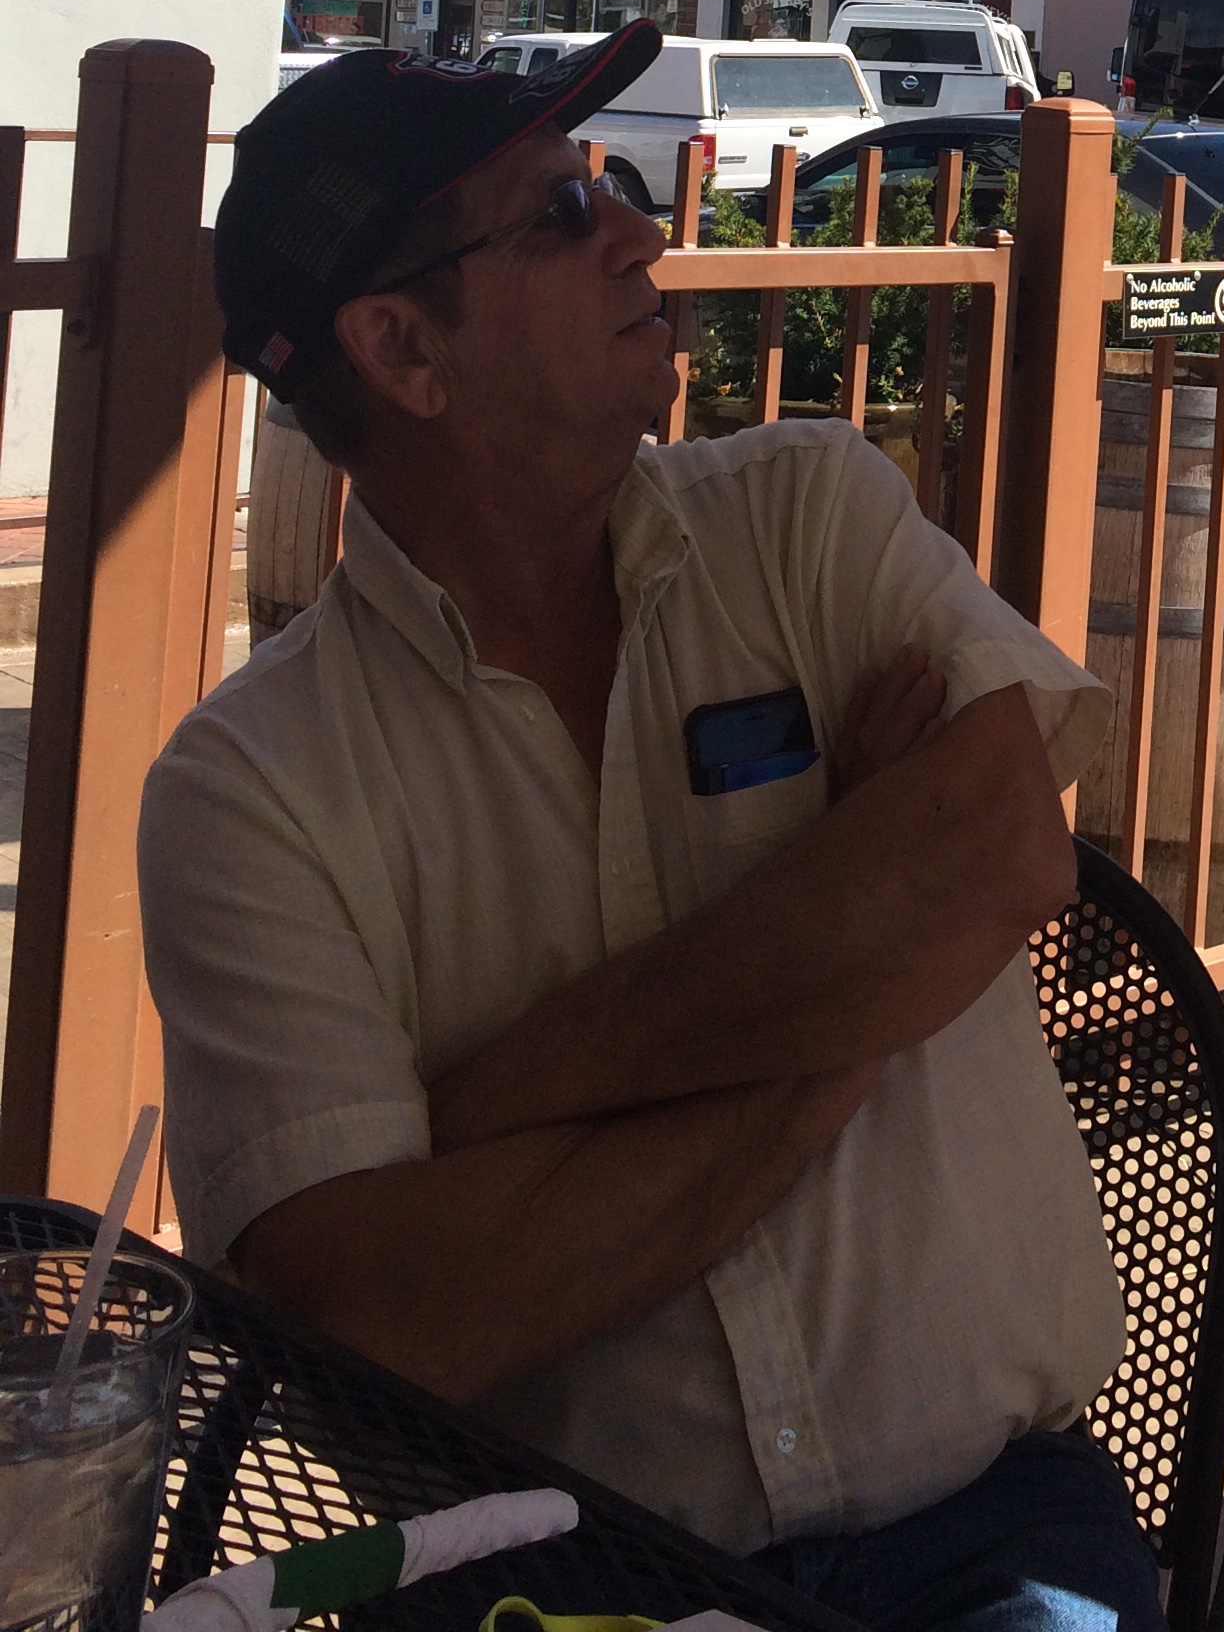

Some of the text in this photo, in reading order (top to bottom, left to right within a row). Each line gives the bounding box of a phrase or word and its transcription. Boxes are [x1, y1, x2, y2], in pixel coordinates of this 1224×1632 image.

[1131, 277, 1196, 293] No Alcoholic
[1130, 296, 1180, 313] Beverages
[1130, 310, 1216, 332] Beyond This Point
